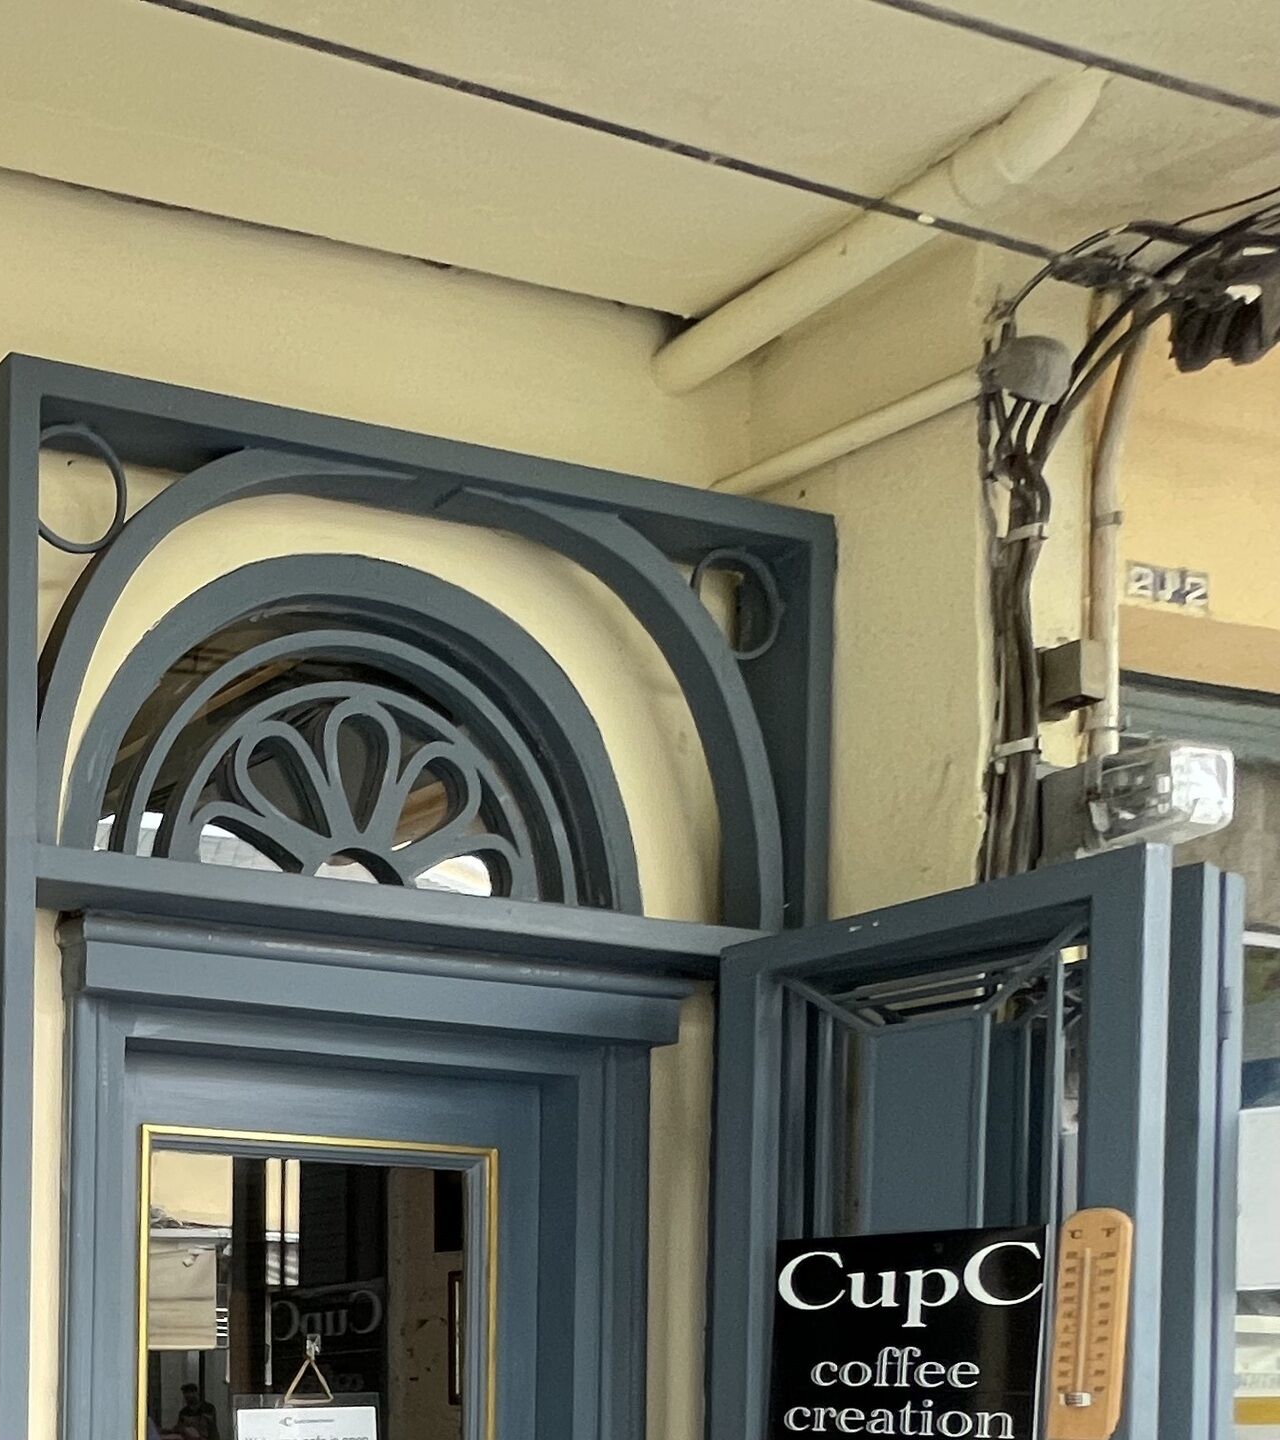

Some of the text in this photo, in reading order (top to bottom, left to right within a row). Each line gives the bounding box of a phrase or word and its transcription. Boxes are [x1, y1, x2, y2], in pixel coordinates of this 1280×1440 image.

[777, 1240, 1045, 1328] CupC
[809, 1346, 981, 1389] coffee
[783, 1398, 1016, 1440] creation
